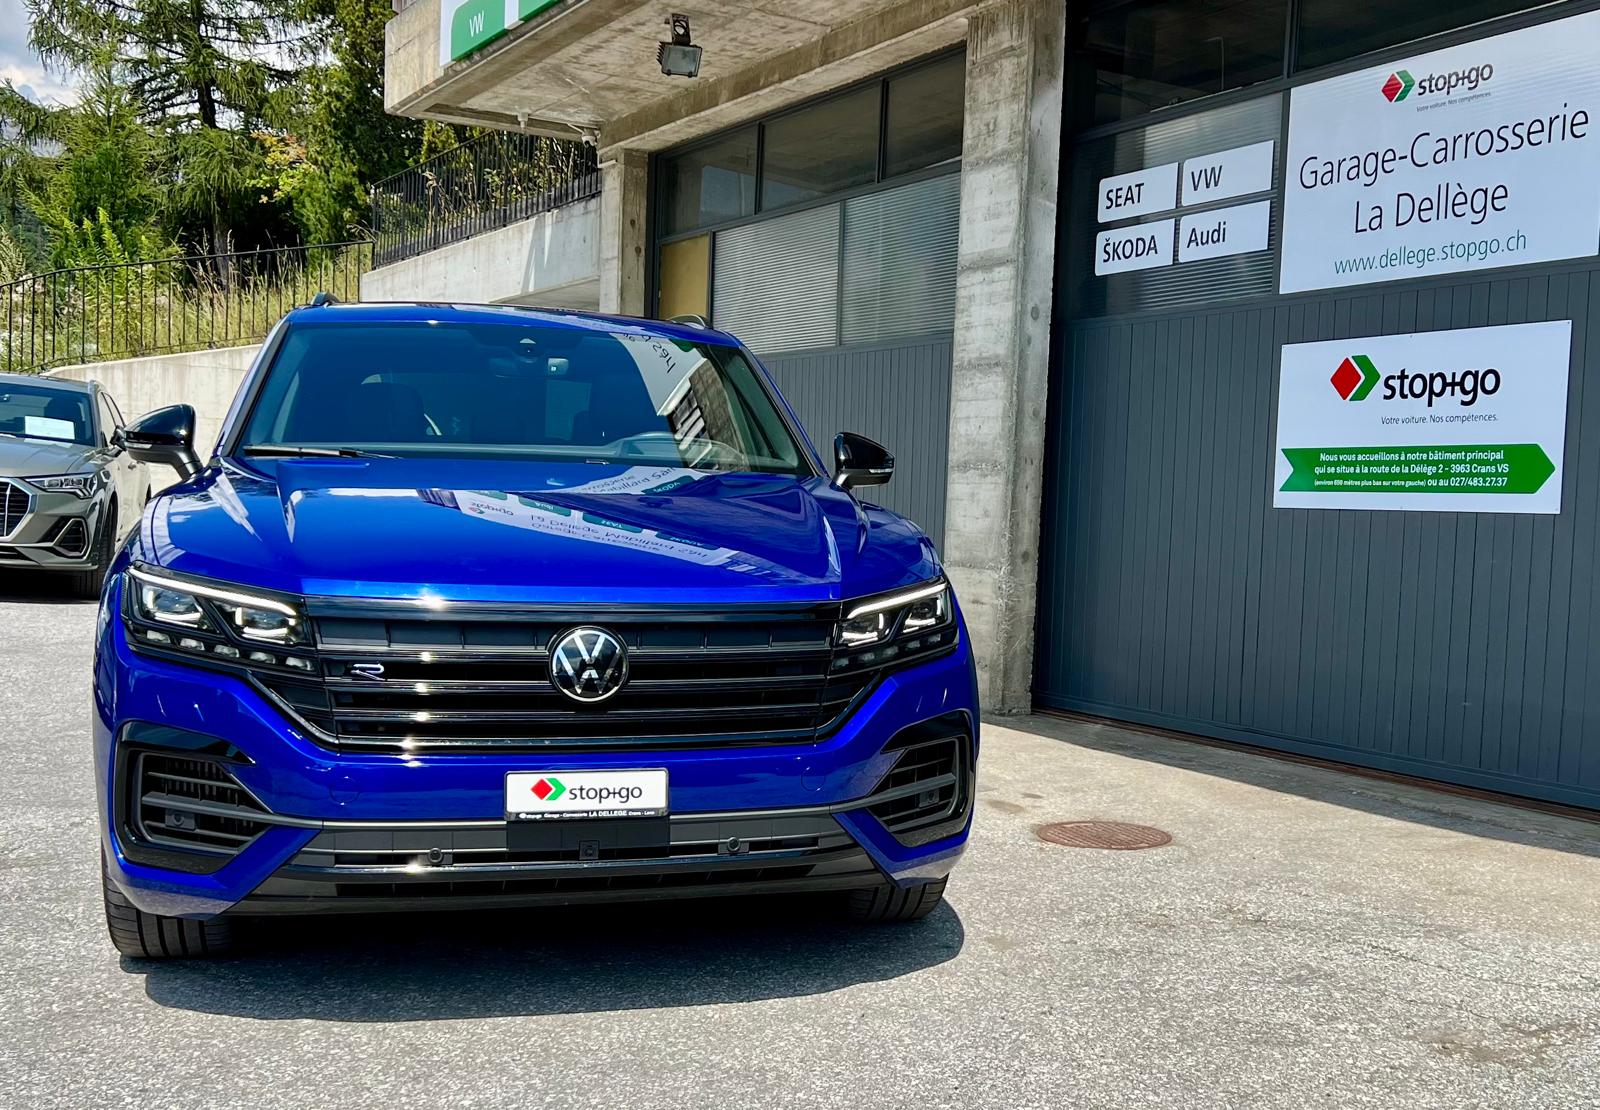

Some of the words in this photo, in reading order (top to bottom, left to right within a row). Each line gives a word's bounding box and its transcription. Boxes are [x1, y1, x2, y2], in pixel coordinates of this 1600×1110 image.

[469, 10, 485, 38] VW
[1417, 63, 1494, 96] stop+go
[1299, 102, 1589, 190] Garage-Carrosserie
[1191, 165, 1223, 192] VW
[1105, 182, 1145, 210] SEAT
[1354, 200, 1383, 234] La
[1395, 182, 1509, 225] Dellège
[1102, 234, 1159, 263] ŠKODA
[1186, 221, 1227, 249] Audi
[1334, 229, 1527, 275] www.dellege.stopgo.ch
[1383, 368, 1501, 408] stop+go
[1381, 416, 1400, 425] Votre
[1401, 415, 1428, 424] voiture.
[1429, 414, 1444, 423] Nos
[1445, 413, 1499, 424] compétences.
[1314, 464, 1326, 475] qui
[1327, 466, 1335, 474] se
[1336, 465, 1354, 474] situe
[1355, 465, 1360, 473] à
[1361, 465, 1368, 473] la
[1369, 465, 1389, 474] route
[1390, 464, 1400, 473] de
[1401, 464, 1409, 473] la
[1438, 464, 1443, 473] 2
[1450, 464, 1471, 473] 3963
[1471, 464, 1496, 473] Crans
[1497, 464, 1509, 473] VS
[1320, 453, 1338, 461] Nous
[1357, 452, 1399, 461] accueillons
[1400, 451, 1405, 460] à
[1406, 451, 1427, 460] notre
[1428, 450, 1465, 460] bâtiment
[1466, 450, 1504, 461] principal
[1450, 477, 1508, 487] 027/483.27.37
[569, 785, 642, 804] stop+go
